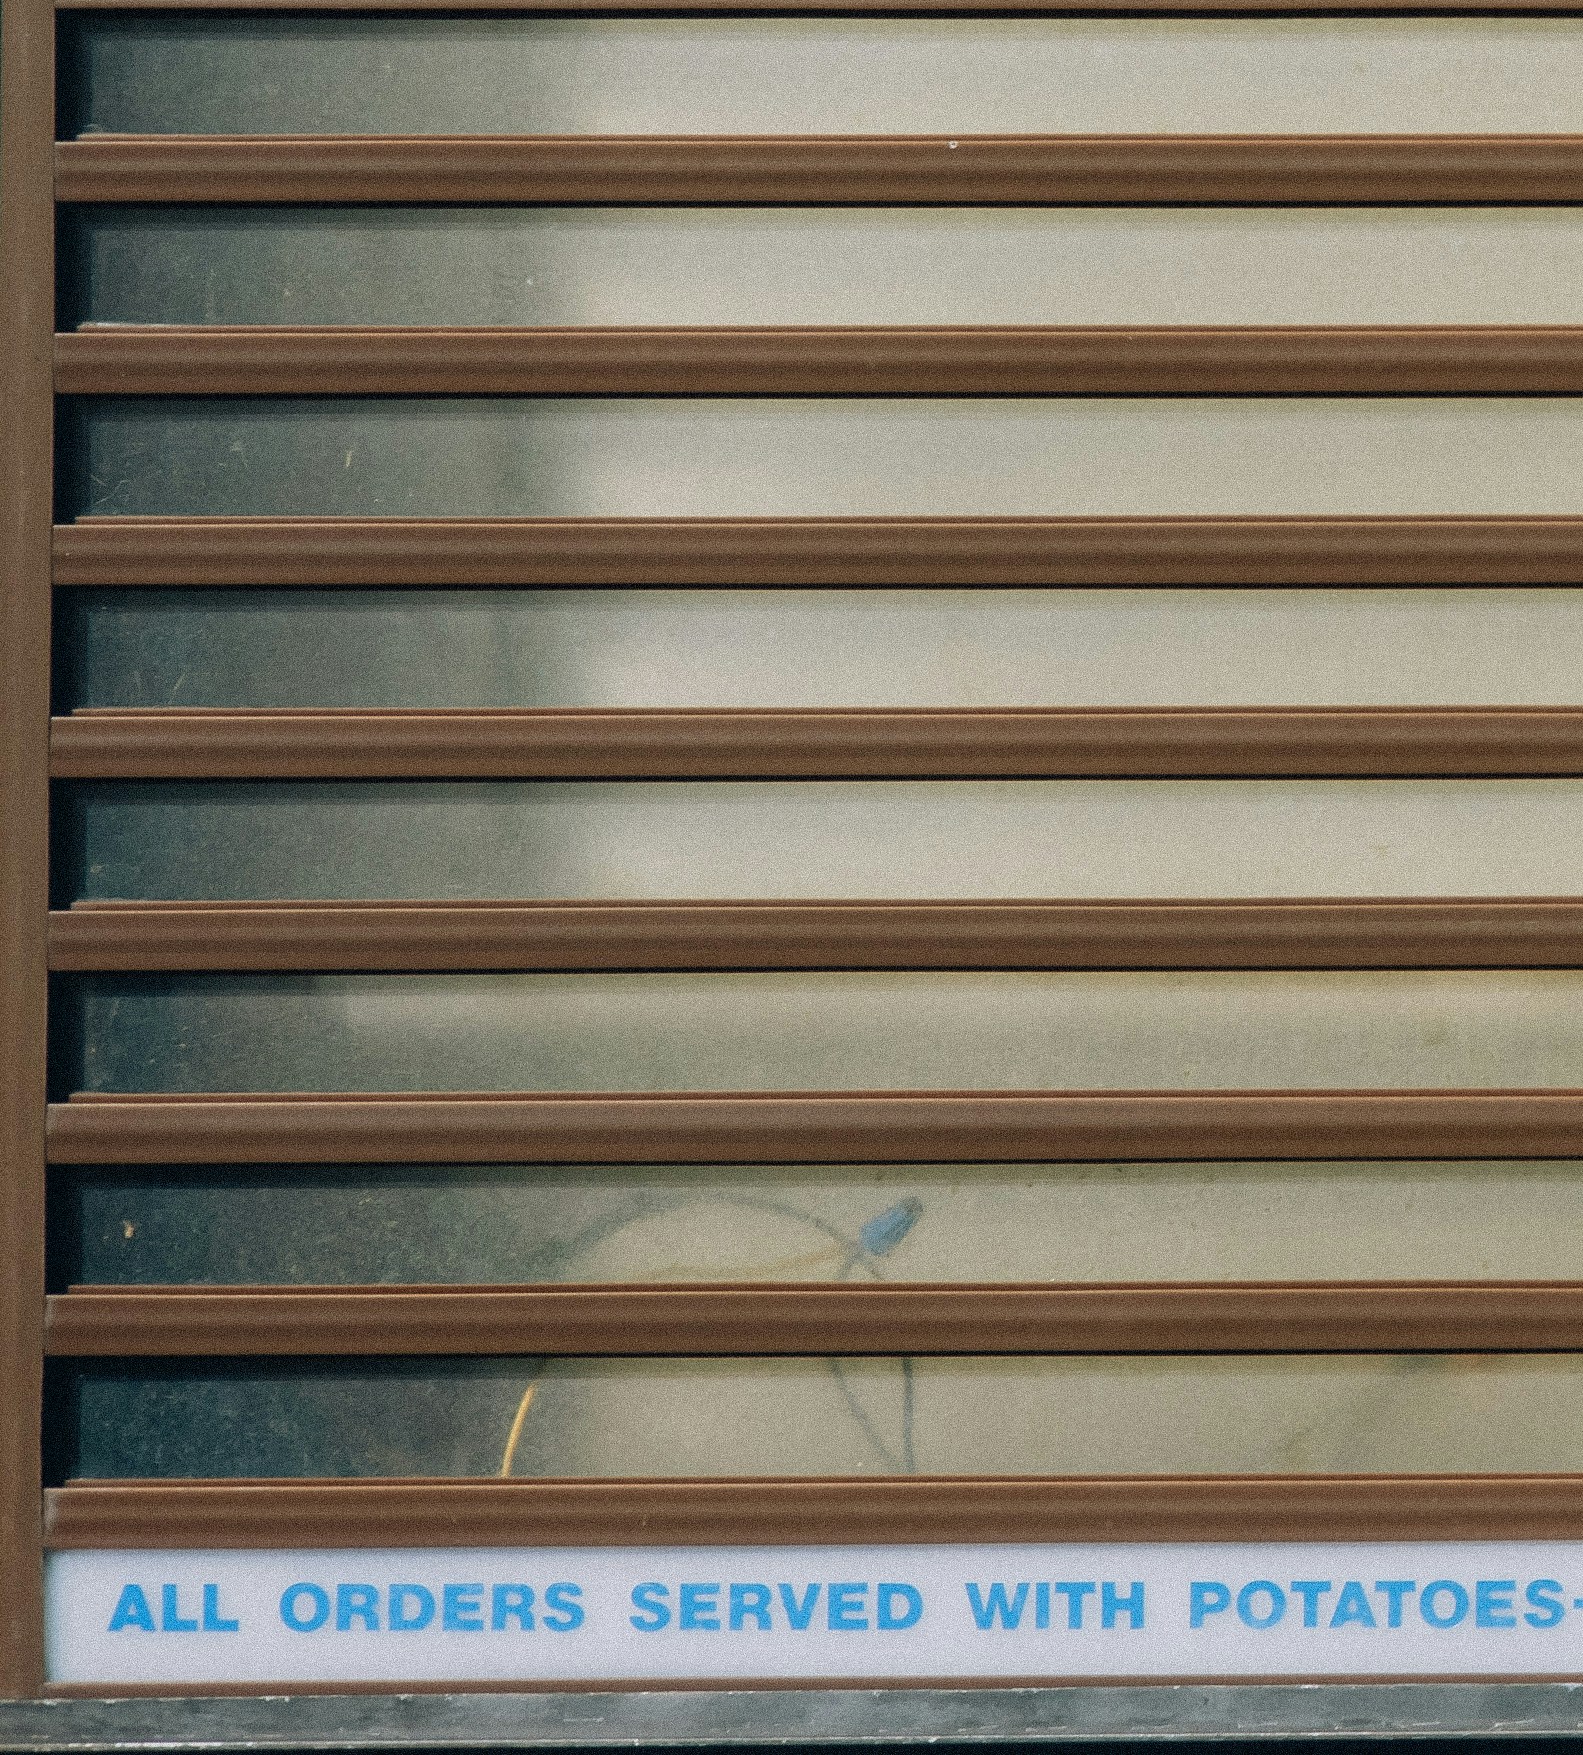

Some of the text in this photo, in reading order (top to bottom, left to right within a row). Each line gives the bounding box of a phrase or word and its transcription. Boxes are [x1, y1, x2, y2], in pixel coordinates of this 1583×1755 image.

[107, 1582, 241, 1634] ALL
[278, 1581, 586, 1634] ORDERS
[629, 1581, 925, 1633] SERVED
[965, 1580, 1146, 1631] WITH
